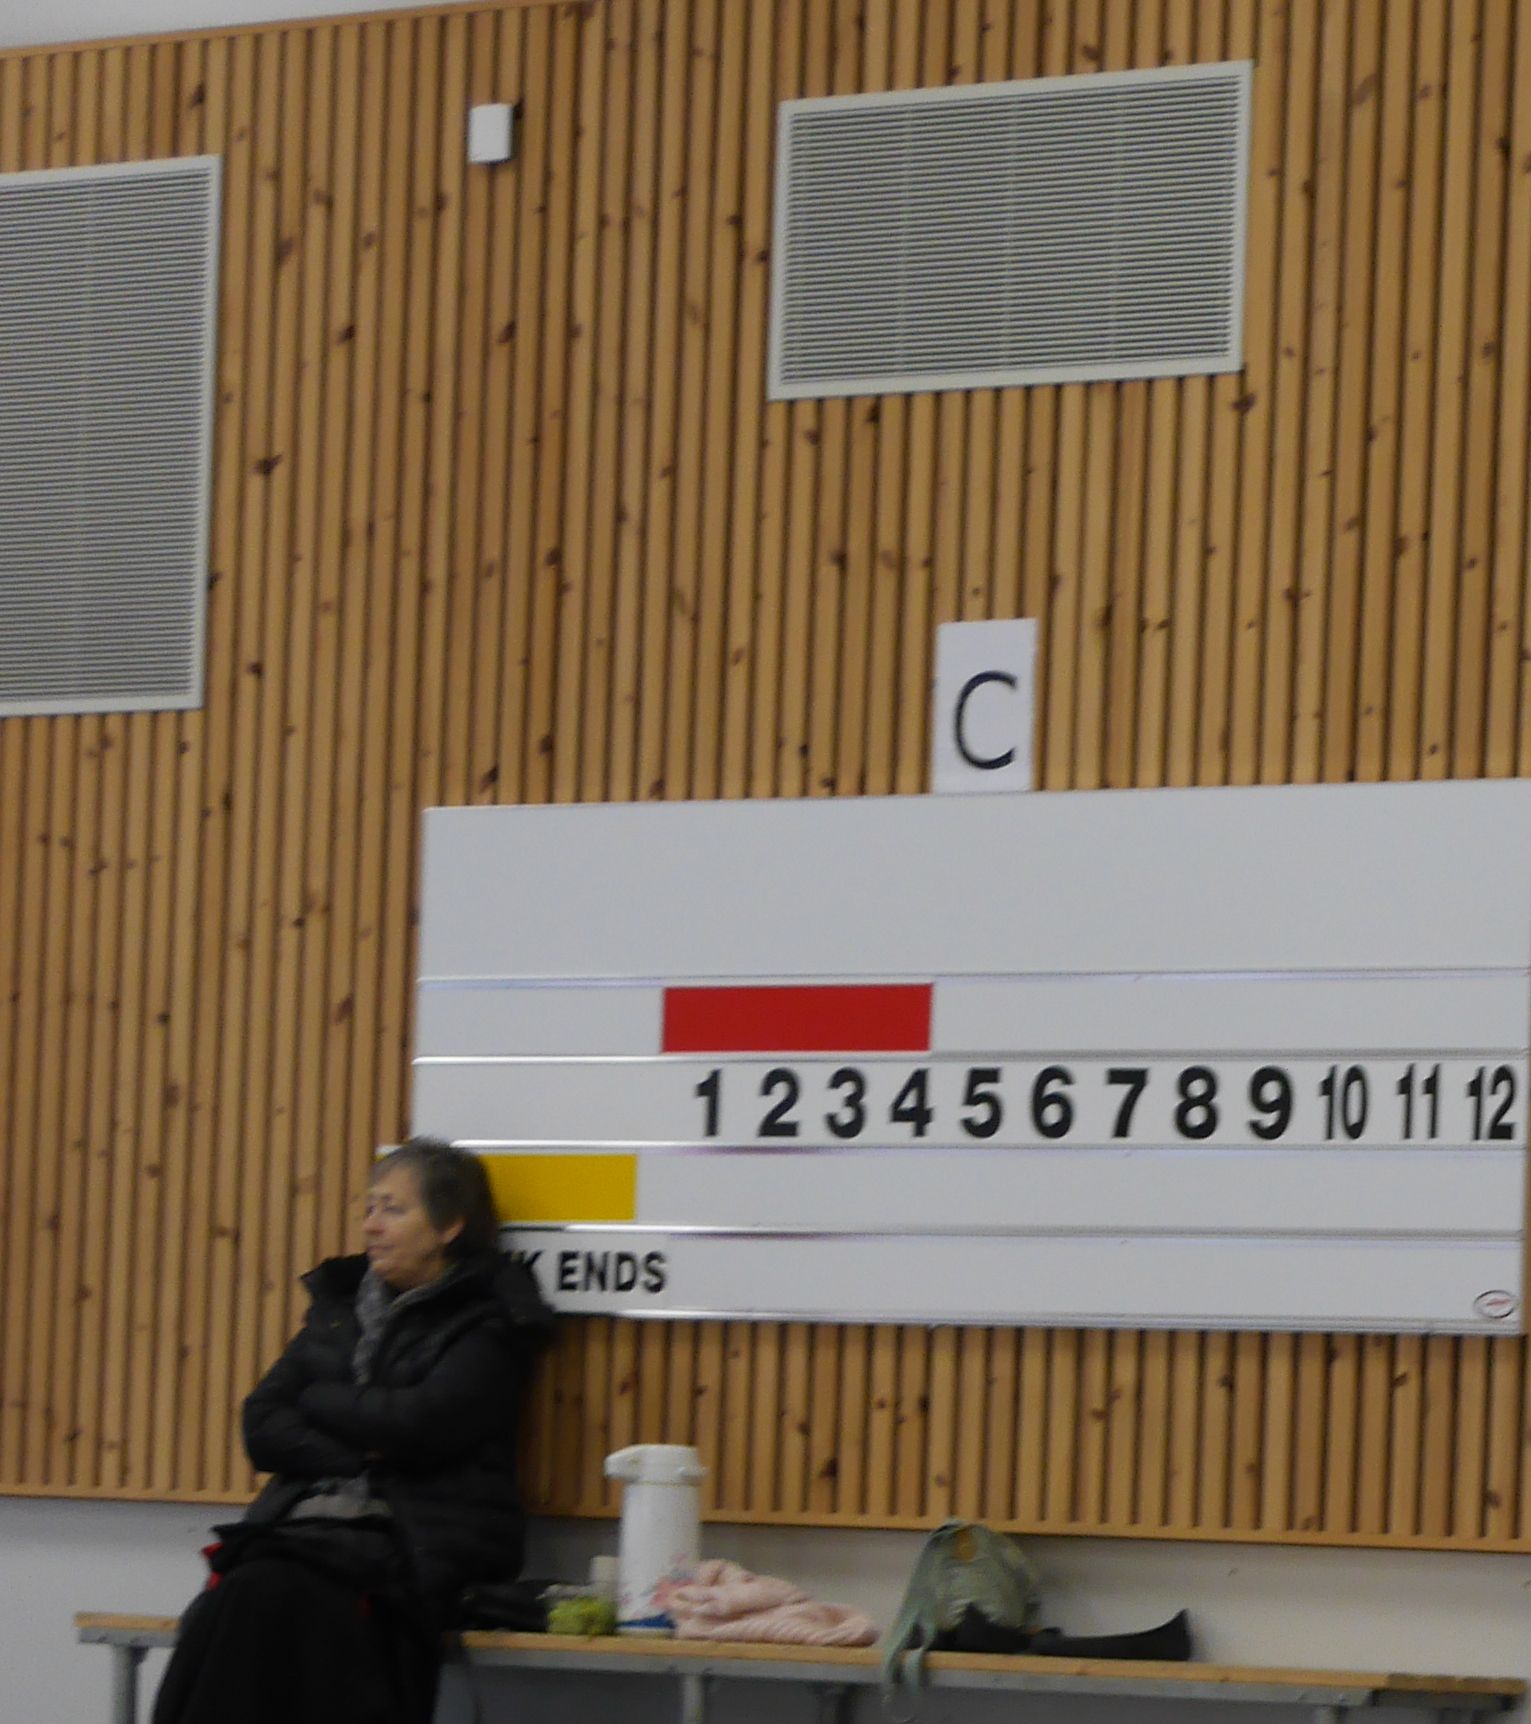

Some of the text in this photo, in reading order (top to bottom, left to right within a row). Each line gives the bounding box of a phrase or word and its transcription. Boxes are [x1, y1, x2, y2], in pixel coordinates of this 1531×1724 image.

[953, 669, 1018, 771] C
[695, 1063, 1517, 1141] 1 2 3 4 5 6 7 8 9 10 11 12
[557, 1250, 667, 1294] ENDS
